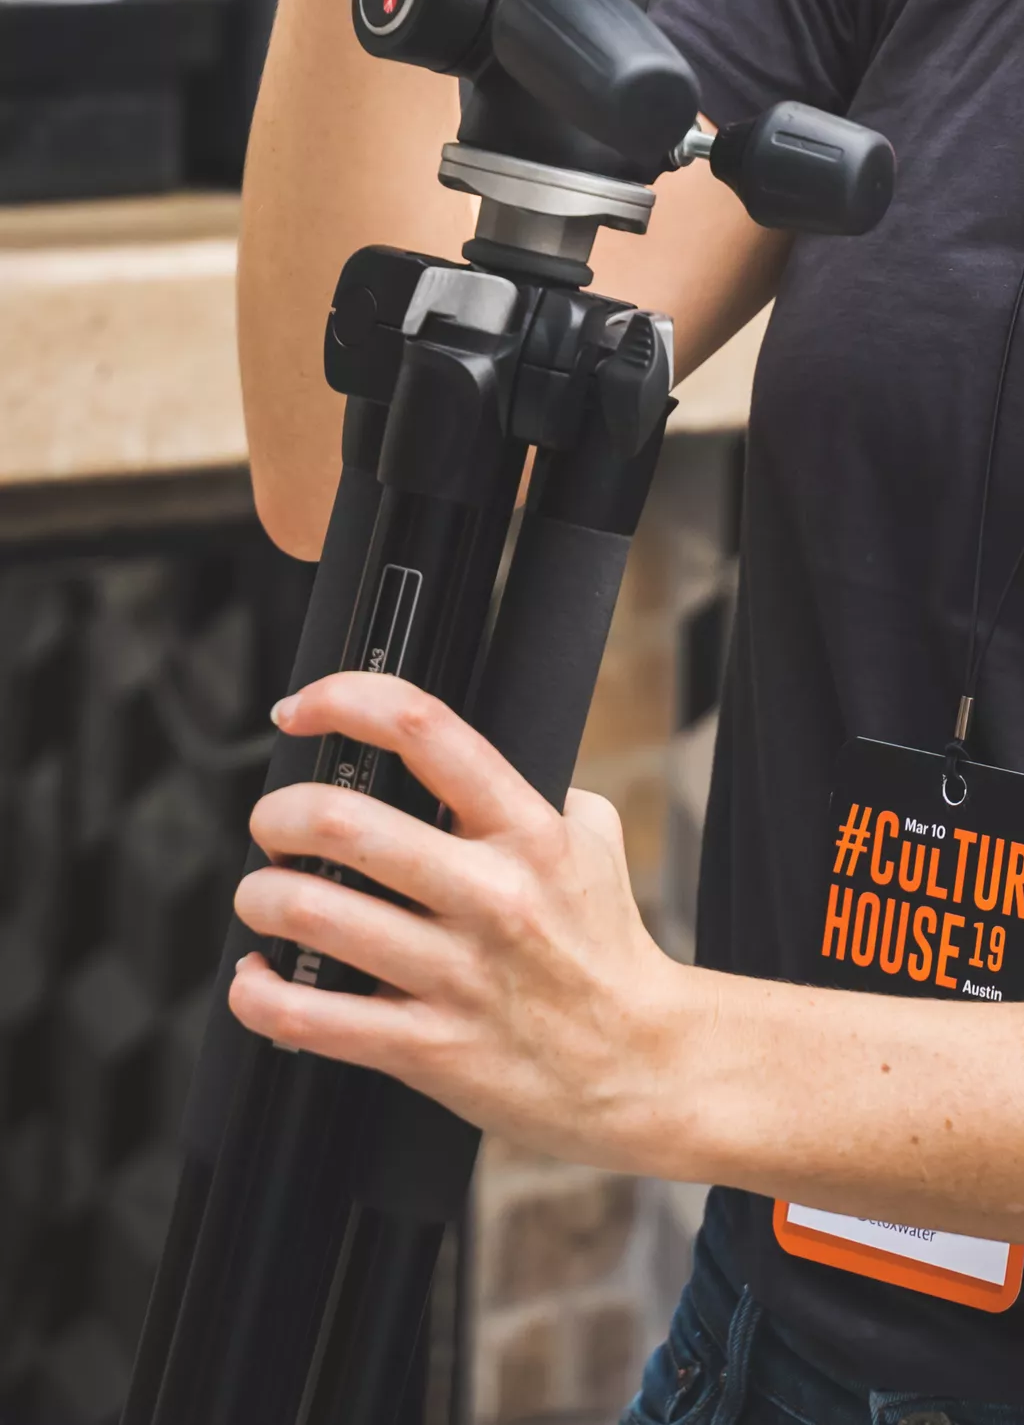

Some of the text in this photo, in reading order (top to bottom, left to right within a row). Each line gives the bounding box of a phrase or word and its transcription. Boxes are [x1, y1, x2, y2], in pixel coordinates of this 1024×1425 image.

[904, 817, 946, 839] Mar 10
[821, 883, 1006, 989] HOUSE 19
[962, 979, 1002, 1001] Austin
[857, 1216, 937, 1243] oxwater
